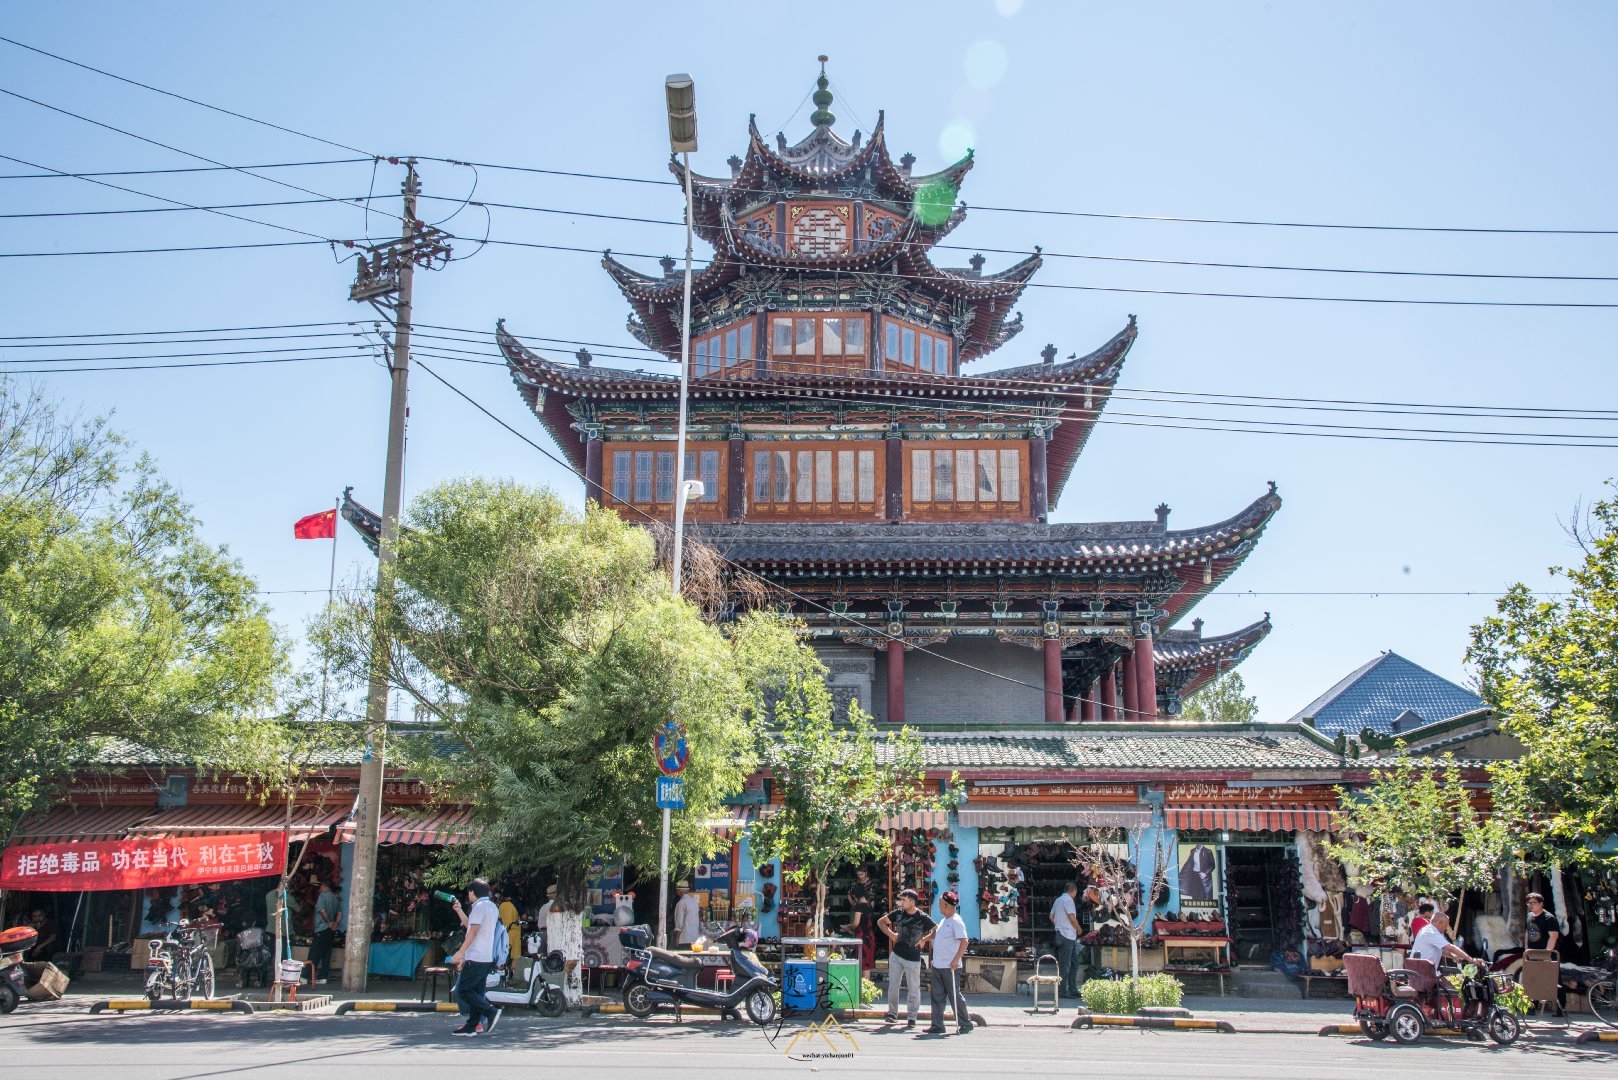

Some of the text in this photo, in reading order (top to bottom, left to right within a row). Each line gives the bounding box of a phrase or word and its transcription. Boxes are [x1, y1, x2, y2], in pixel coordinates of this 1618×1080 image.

[18, 841, 274, 876] 拒绝毒品 功在当代 利在千秋
